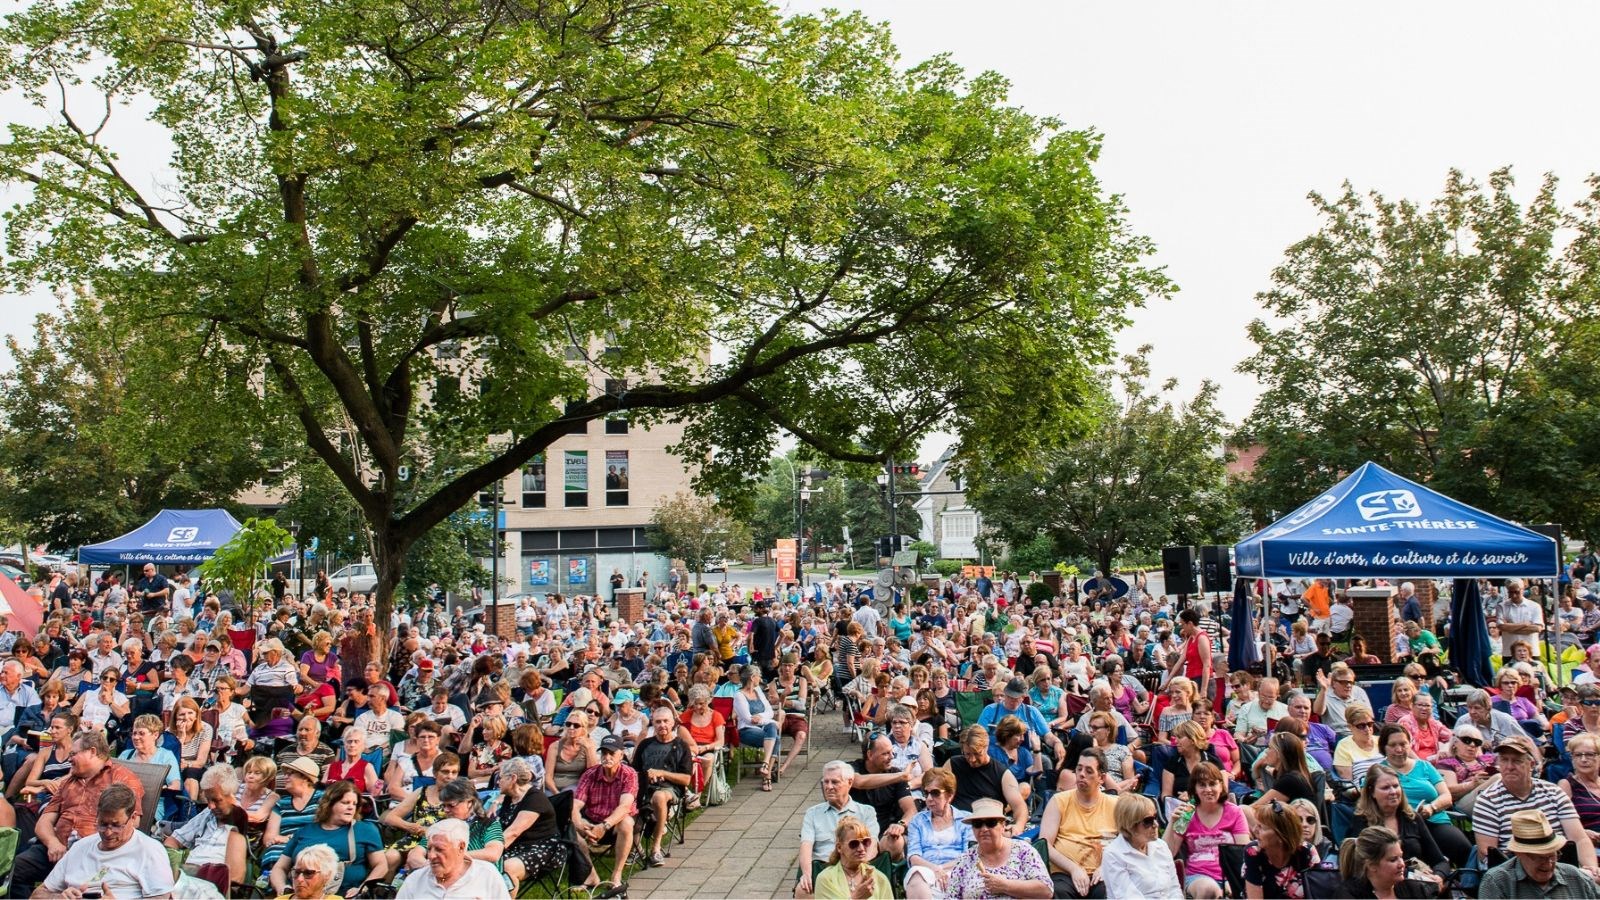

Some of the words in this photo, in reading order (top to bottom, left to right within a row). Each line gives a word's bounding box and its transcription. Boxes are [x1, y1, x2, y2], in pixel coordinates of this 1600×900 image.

[398, 465, 409, 481] 9
[1321, 519, 1480, 535] SAINTE-THÉRÈSE
[120, 552, 134, 561] Ville
[155, 553, 163, 561] de
[164, 553, 187, 561] culture
[194, 553, 202, 561] de
[1288, 551, 1321, 566] Ville
[1323, 551, 1369, 567] d'arts,
[1372, 551, 1390, 566] de
[1391, 550, 1443, 565] culture
[1445, 552, 1460, 566] et
[1461, 551, 1480, 565] de
[1481, 551, 1529, 566] savoir
